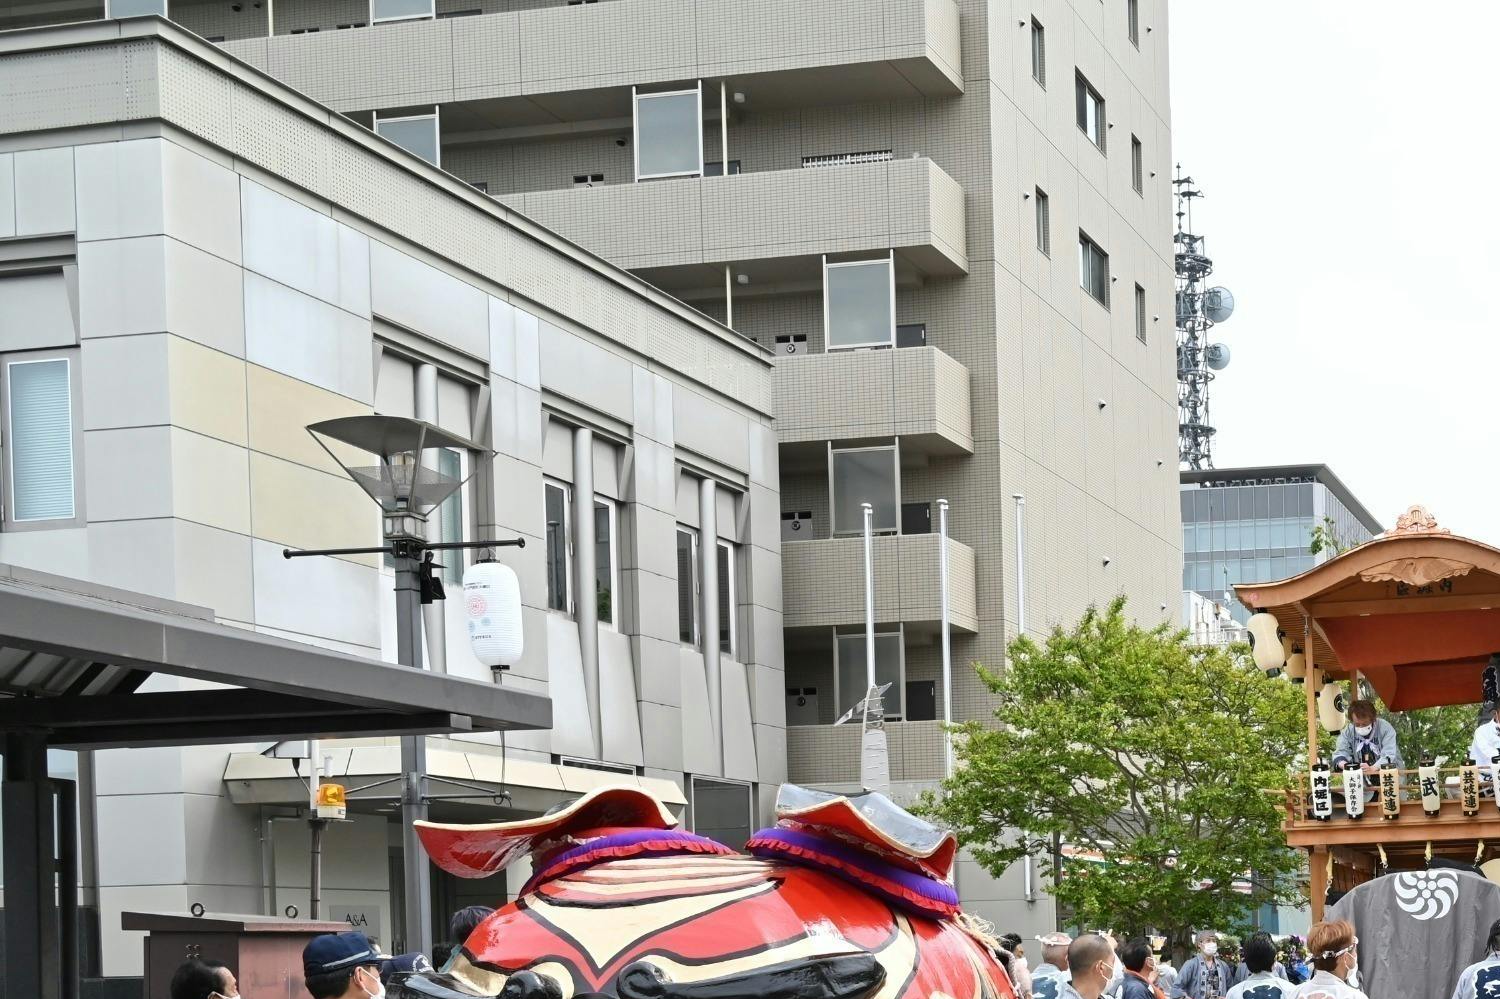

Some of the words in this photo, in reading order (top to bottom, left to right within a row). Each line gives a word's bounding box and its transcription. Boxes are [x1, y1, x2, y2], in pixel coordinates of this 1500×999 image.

[1313, 776, 1329, 811] 内堀区
[1382, 773, 1397, 812] 芸妓連
[1422, 776, 1438, 797] 武
[1463, 770, 1477, 808] 芸妓連
[345, 912, 368, 927] A&A
